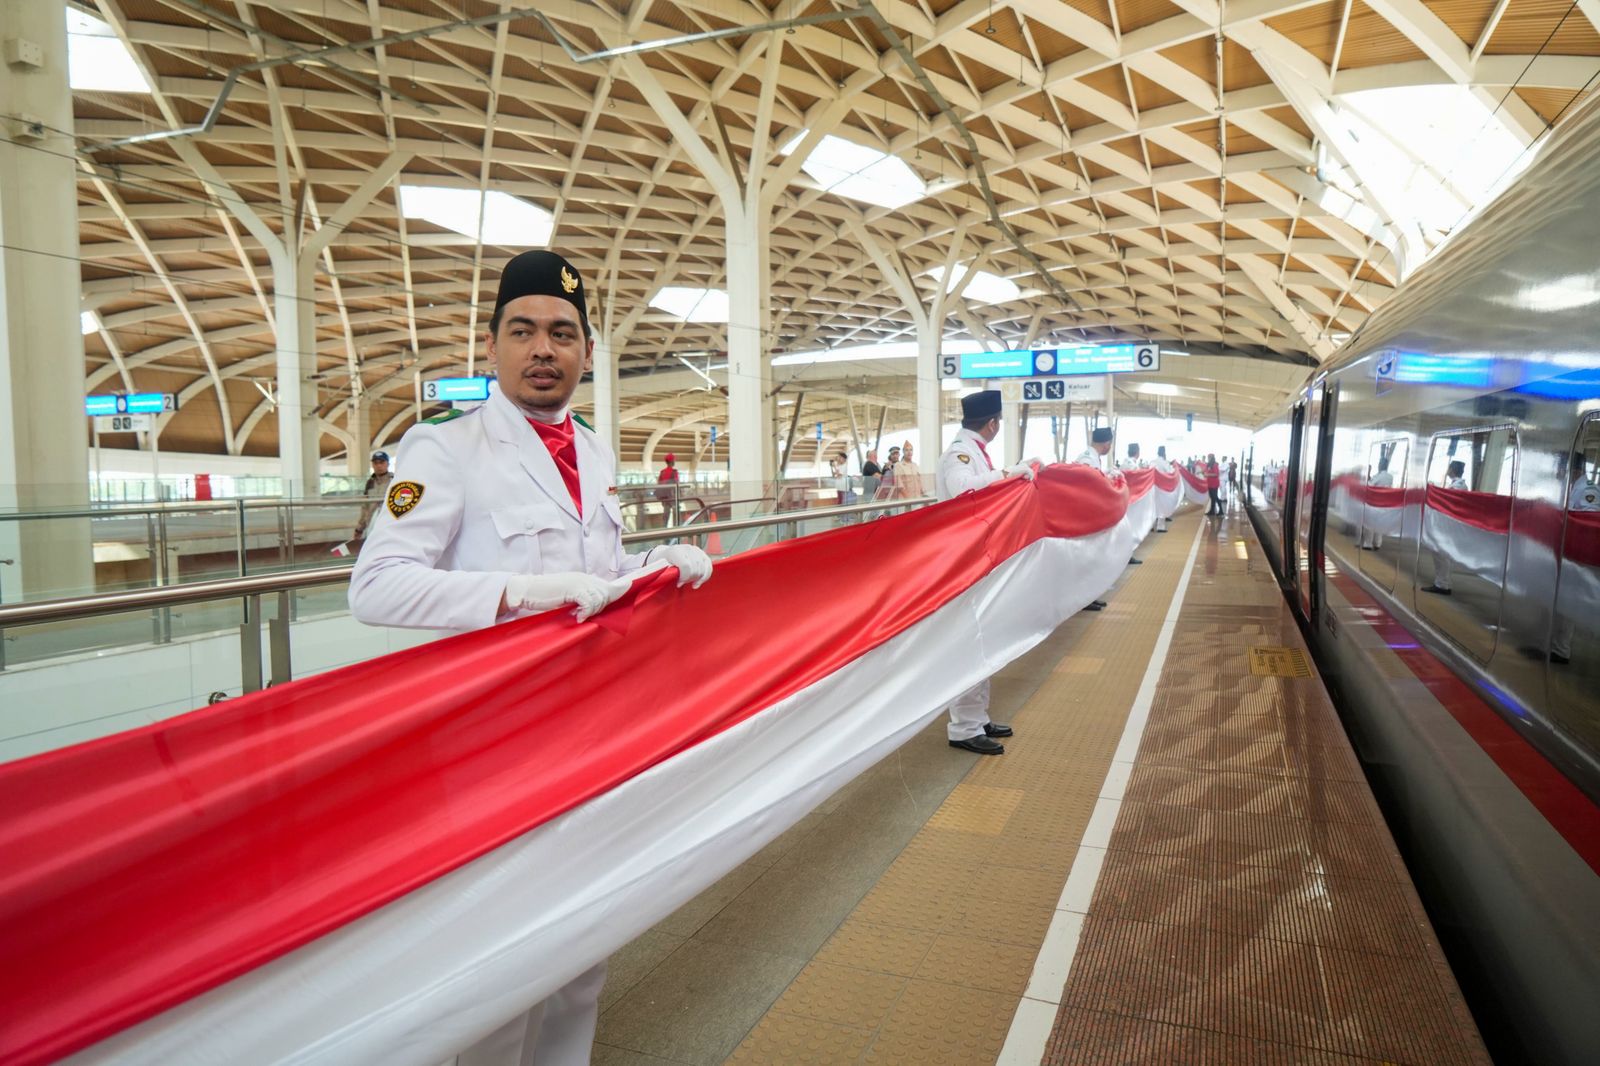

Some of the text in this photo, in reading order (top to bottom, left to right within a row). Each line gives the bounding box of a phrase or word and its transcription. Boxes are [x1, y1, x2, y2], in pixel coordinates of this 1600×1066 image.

[943, 356, 956, 376] 5
[1137, 348, 1153, 368] 6
[427, 383, 437, 398] 3
[164, 396, 172, 410] 2
